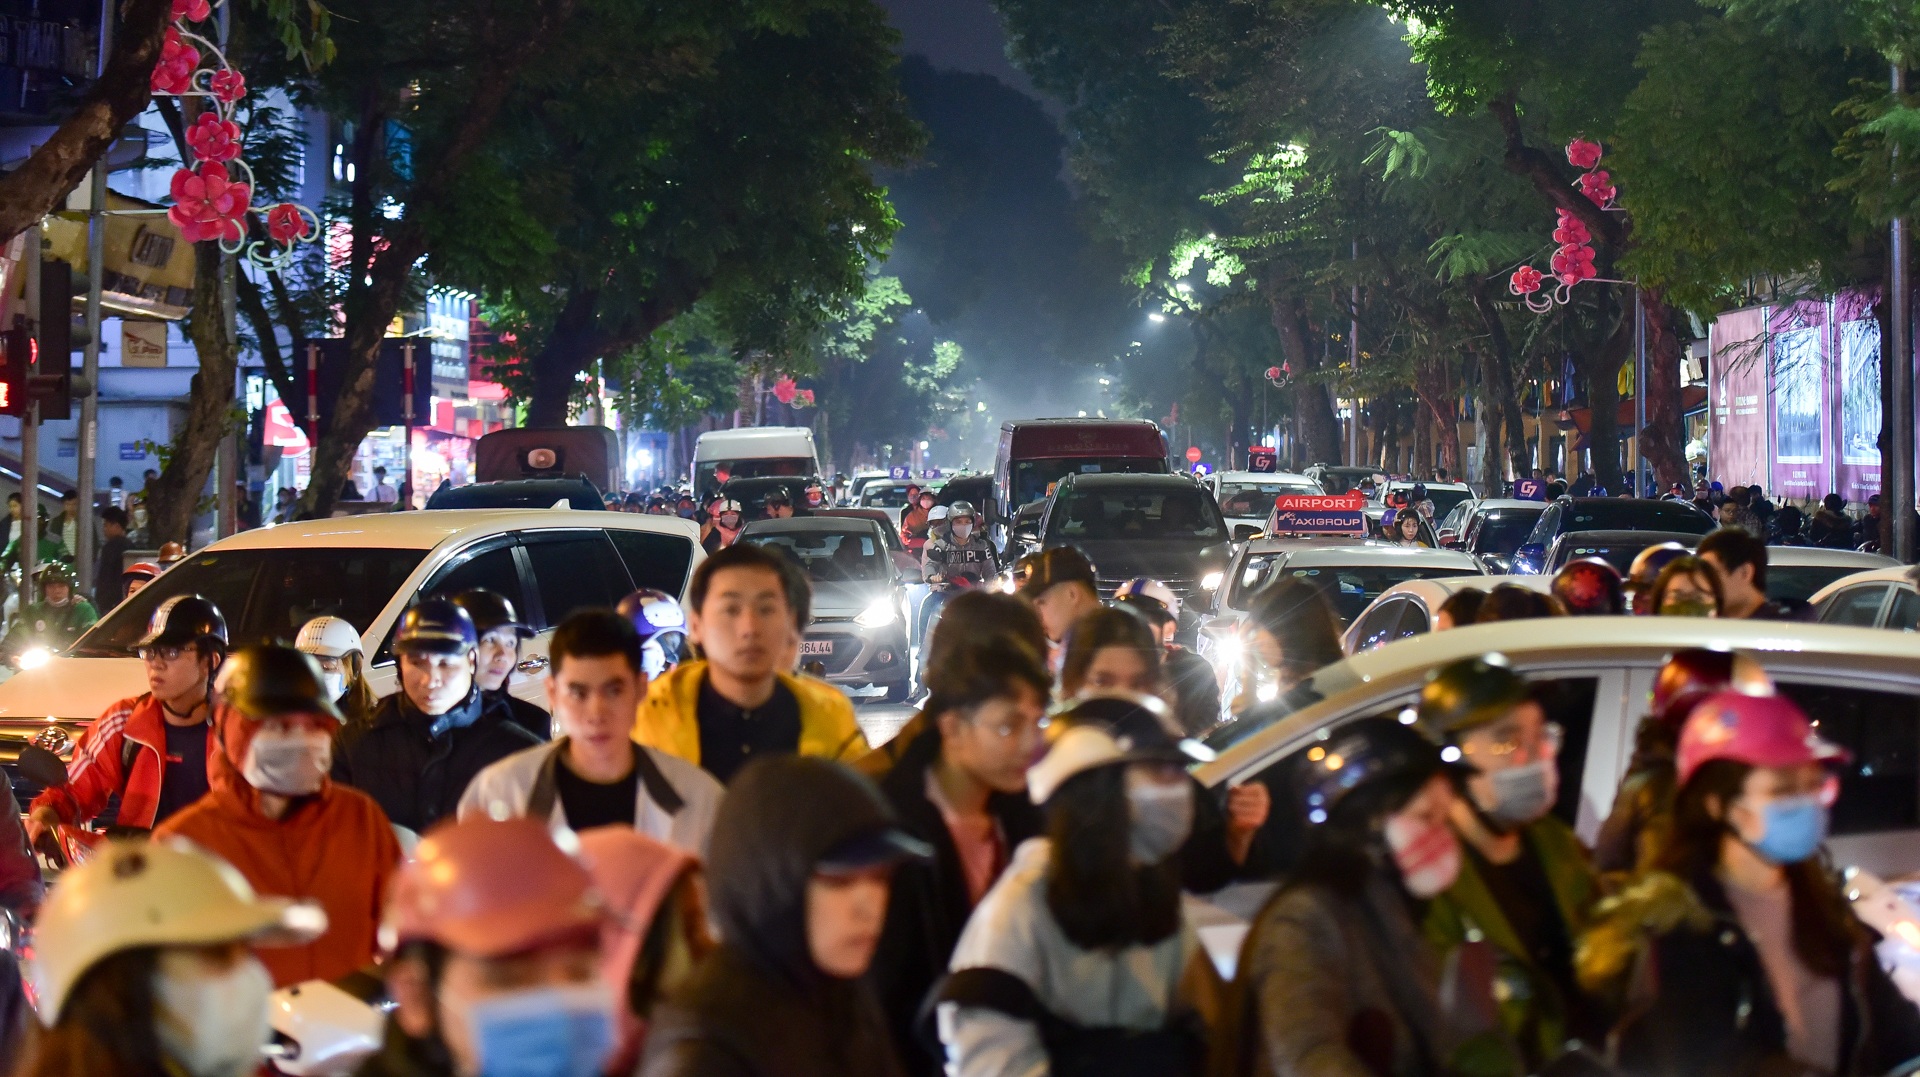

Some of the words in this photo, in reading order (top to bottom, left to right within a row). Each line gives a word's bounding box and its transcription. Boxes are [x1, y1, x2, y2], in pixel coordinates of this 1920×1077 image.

[1256, 456, 1270, 471] G7
[1521, 481, 1537, 497] G7
[1282, 498, 1357, 508] AIRPORT
[1289, 518, 1361, 526] TAXIGROUP
